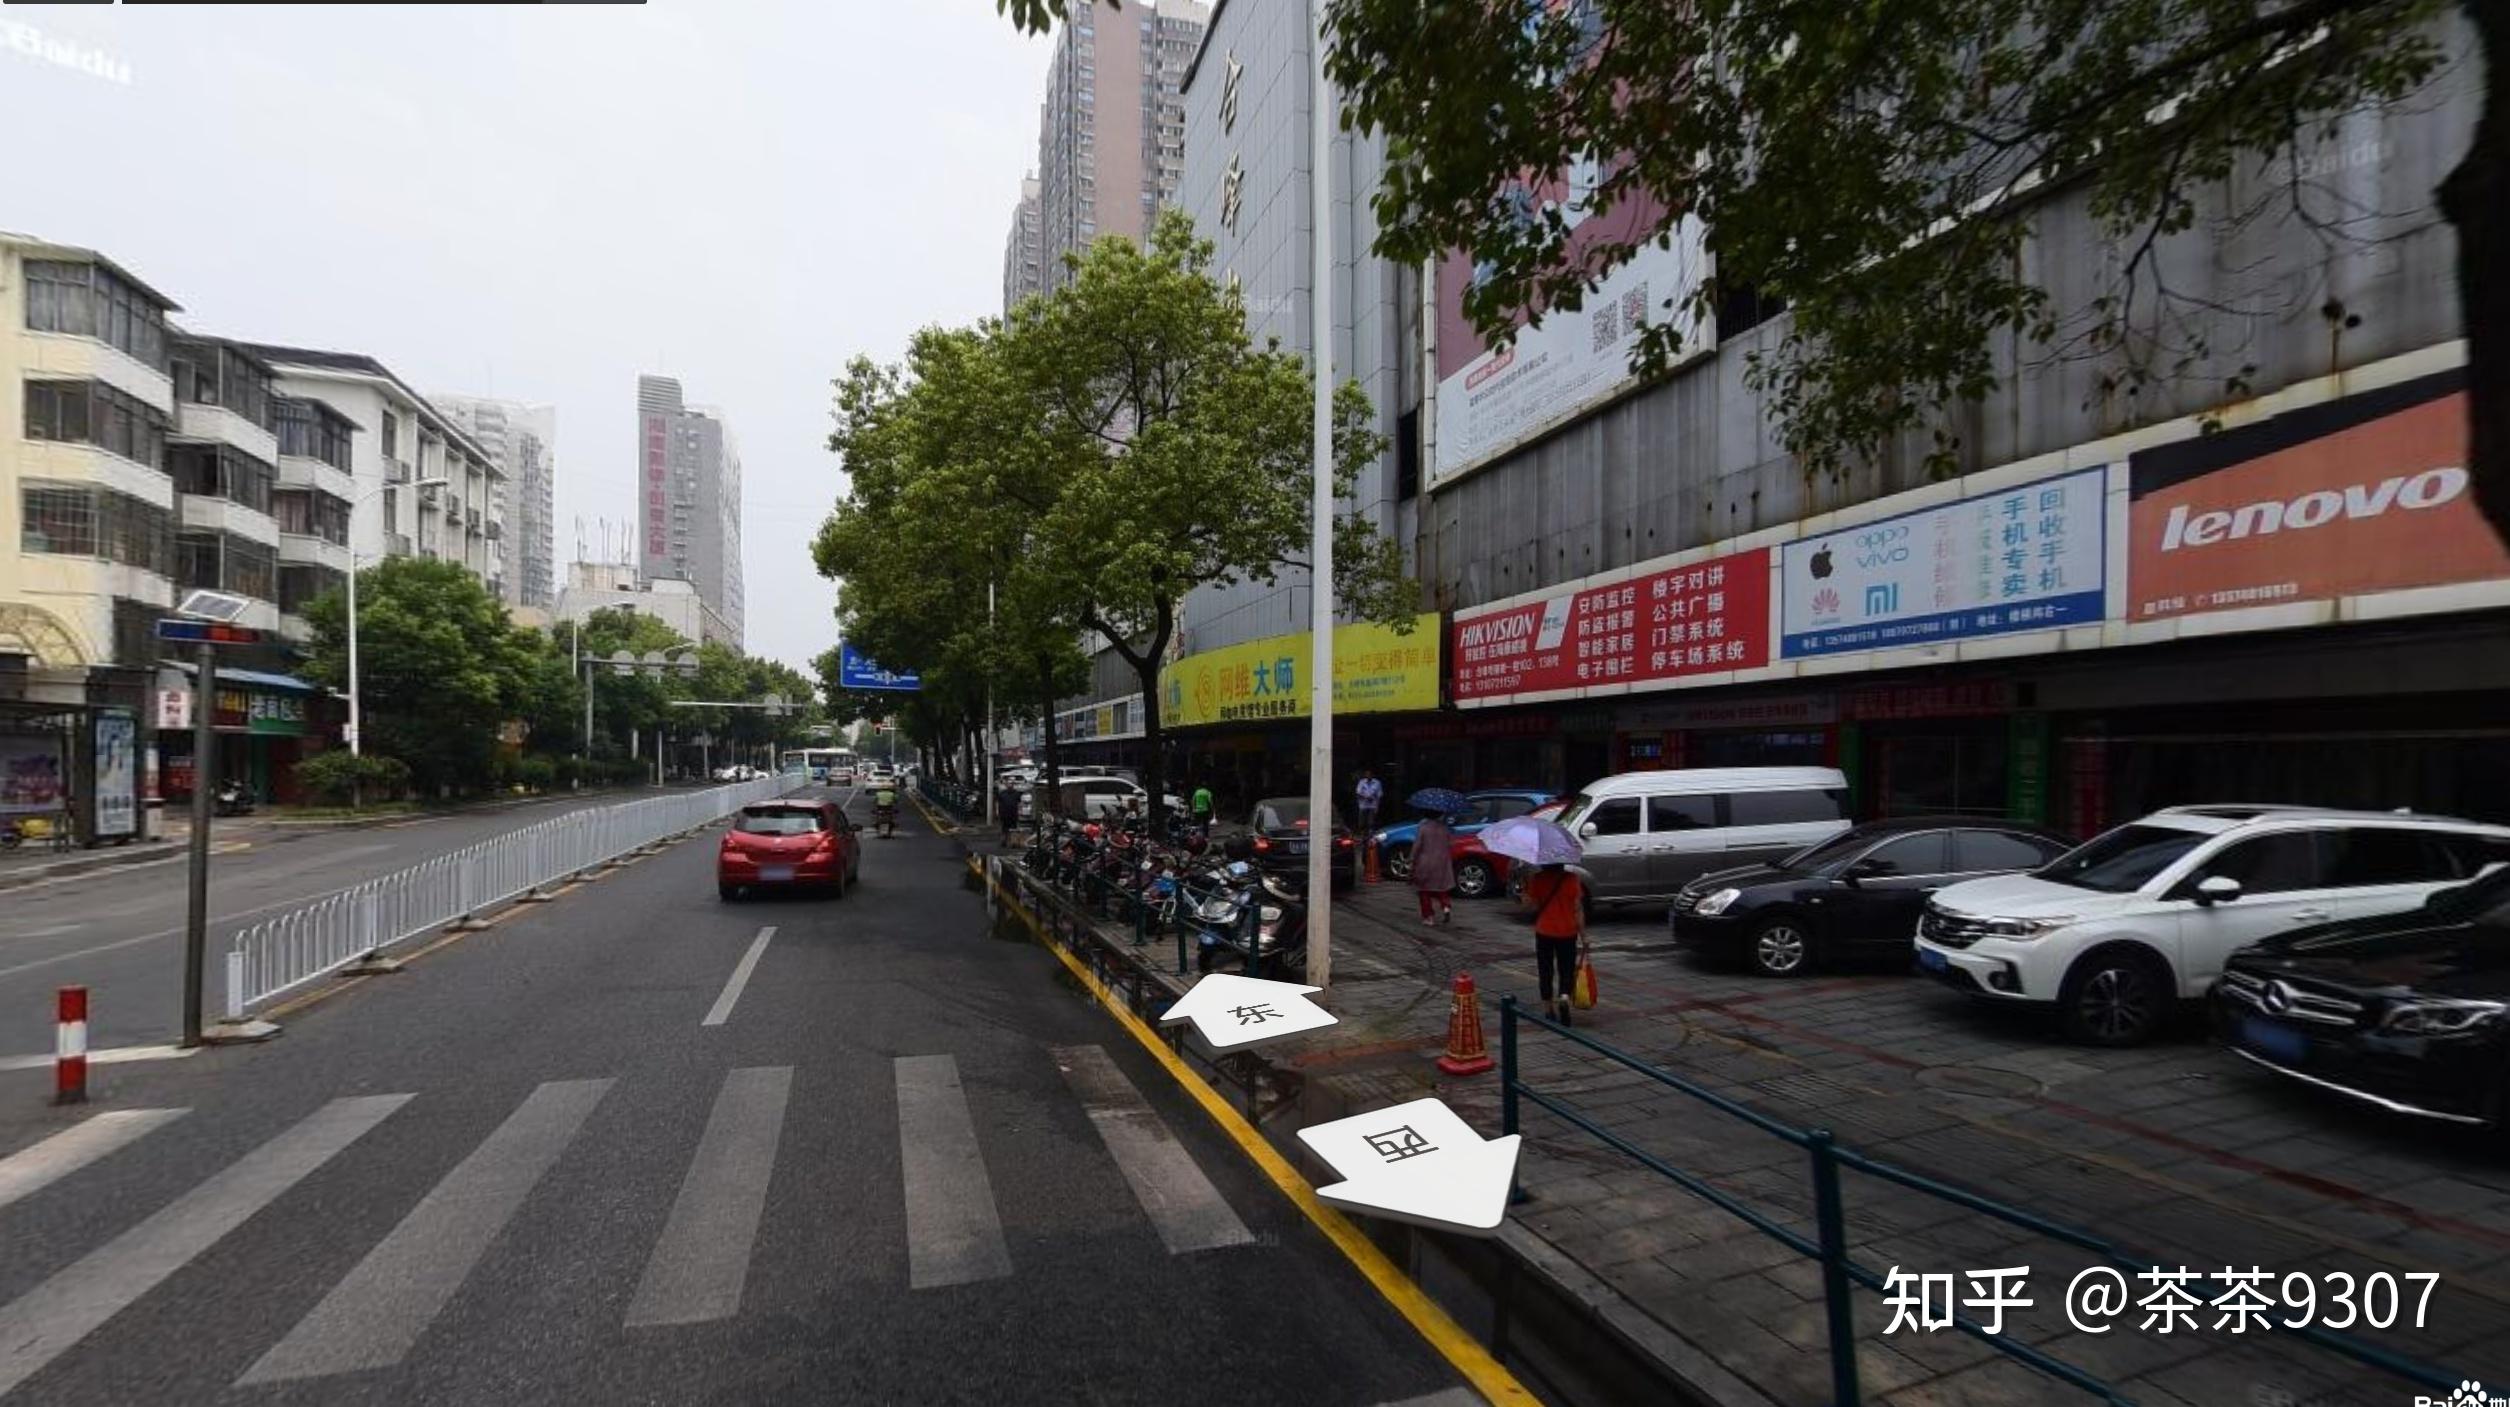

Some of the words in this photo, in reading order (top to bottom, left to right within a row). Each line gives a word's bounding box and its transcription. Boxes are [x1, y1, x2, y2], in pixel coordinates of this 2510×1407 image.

[2161, 466, 2470, 552] lenovo
[2001, 495, 2029, 597] 手机专卖
[2037, 487, 2067, 592] 回收手机
[1855, 547, 1910, 570] vivo
[1652, 566, 1724, 600] 楼宇对讲
[1578, 587, 1637, 615] 安防监控
[1652, 591, 1725, 623] 公共广播
[1459, 612, 1537, 648] HIKVISION
[1578, 610, 1636, 638] 防盗报警
[1651, 617, 1725, 647] 门禁系统
[1577, 633, 1635, 658] 智能家居
[1651, 640, 1746, 671] 停车场系统
[1219, 656, 1294, 702] 网维大师
[1577, 656, 1634, 679] 电子围栏
